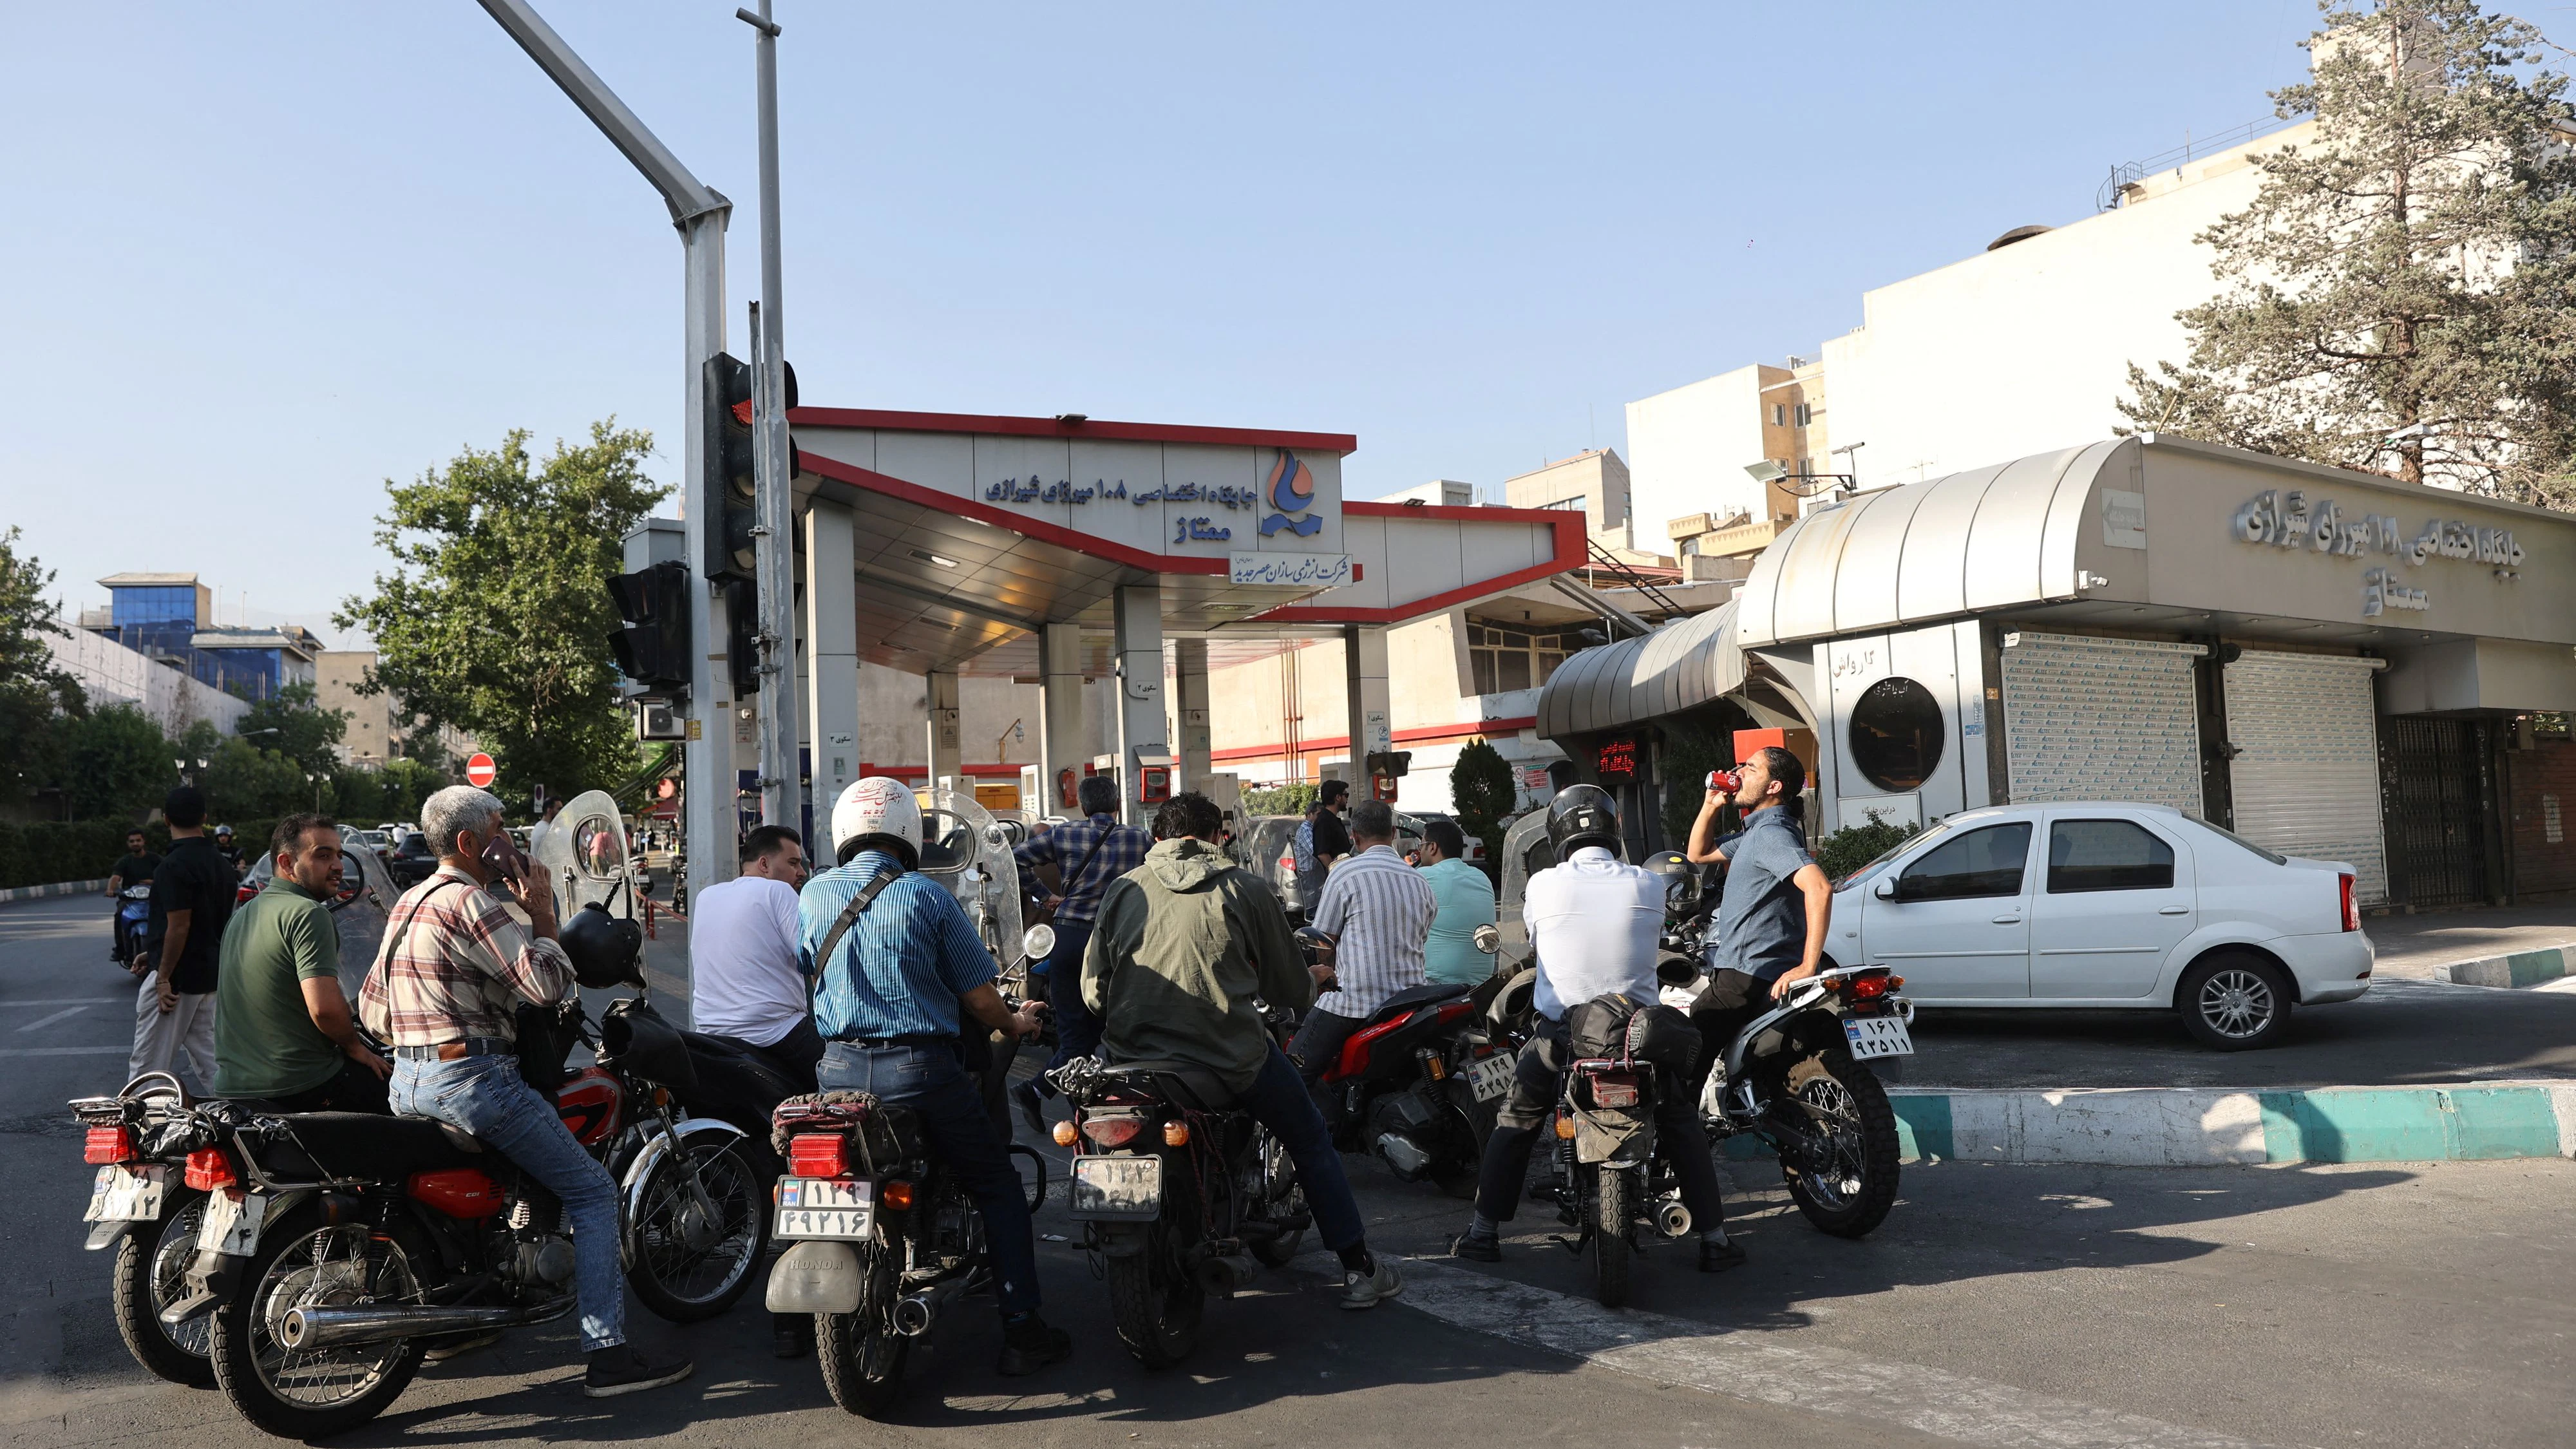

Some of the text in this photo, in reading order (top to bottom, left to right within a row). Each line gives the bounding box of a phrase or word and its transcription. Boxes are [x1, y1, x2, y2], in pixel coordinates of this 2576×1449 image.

[986, 475, 1257, 508] جایگاه اختصاصی ۱۰۸ میرزای شیرازی
[1174, 516, 1231, 544] ممتاز
[2237, 489, 2311, 549] شیرازی
[2315, 500, 2371, 558] میرزای
[2403, 520, 2481, 566] اختصاصی
[2482, 529, 2526, 580] جایگاه
[1235, 555, 1349, 583] شرکت انرژی سازان عصر جدید
[2365, 567, 2430, 618] ممتاز
[1867, 1020, 1897, 1035] ۱۶۱
[1856, 1037, 1909, 1055] ۹۳۵۱۱
[1484, 1057, 1509, 1076] ۱۴۹
[1478, 1073, 1514, 1099] ۶۳۹۵
[815, 1182, 858, 1204] ۱۲۹
[785, 1211, 866, 1234] ۴۹۲۱۶
[790, 1260, 844, 1270] HONDA
